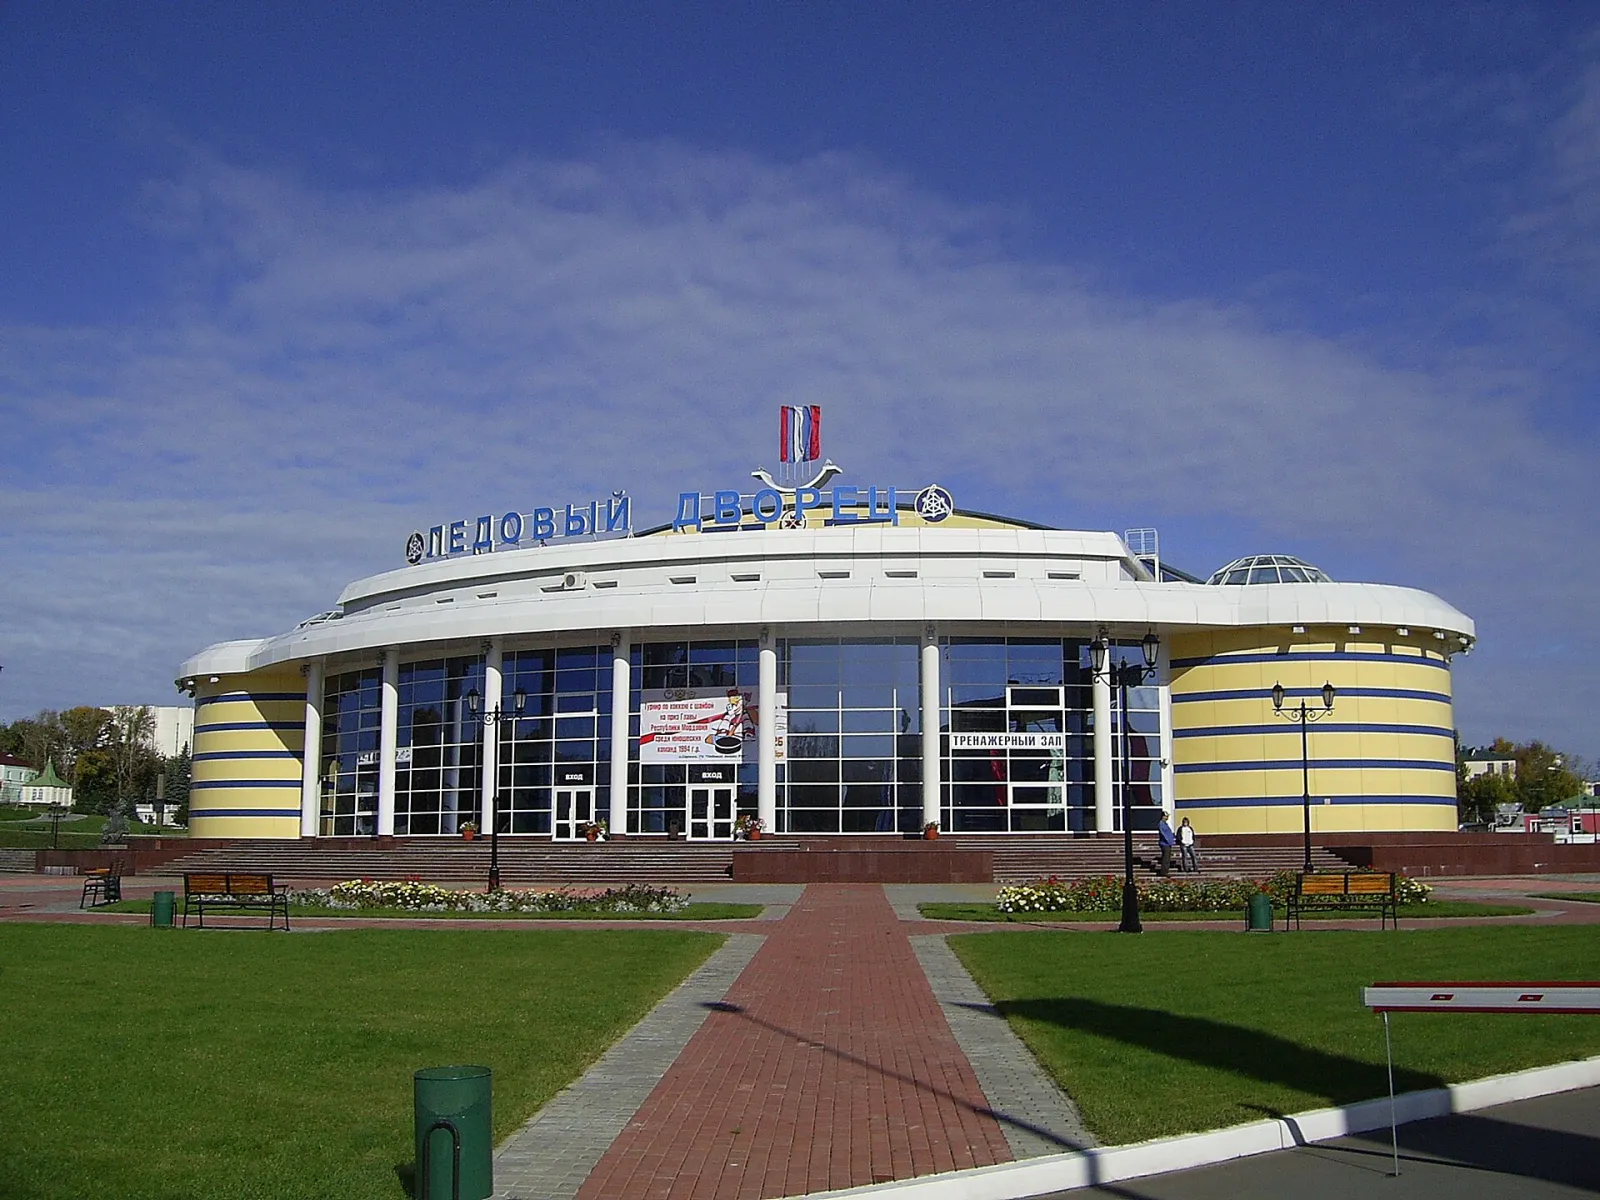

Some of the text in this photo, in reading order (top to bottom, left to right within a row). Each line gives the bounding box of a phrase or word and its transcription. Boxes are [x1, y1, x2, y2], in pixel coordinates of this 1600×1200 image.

[426, 486, 898, 558] ЛЕДОВЫЙ ДВОРЕЦ
[953, 735, 1062, 746] ТРЕНАЖЕРНЫЙ ЗАЛ
